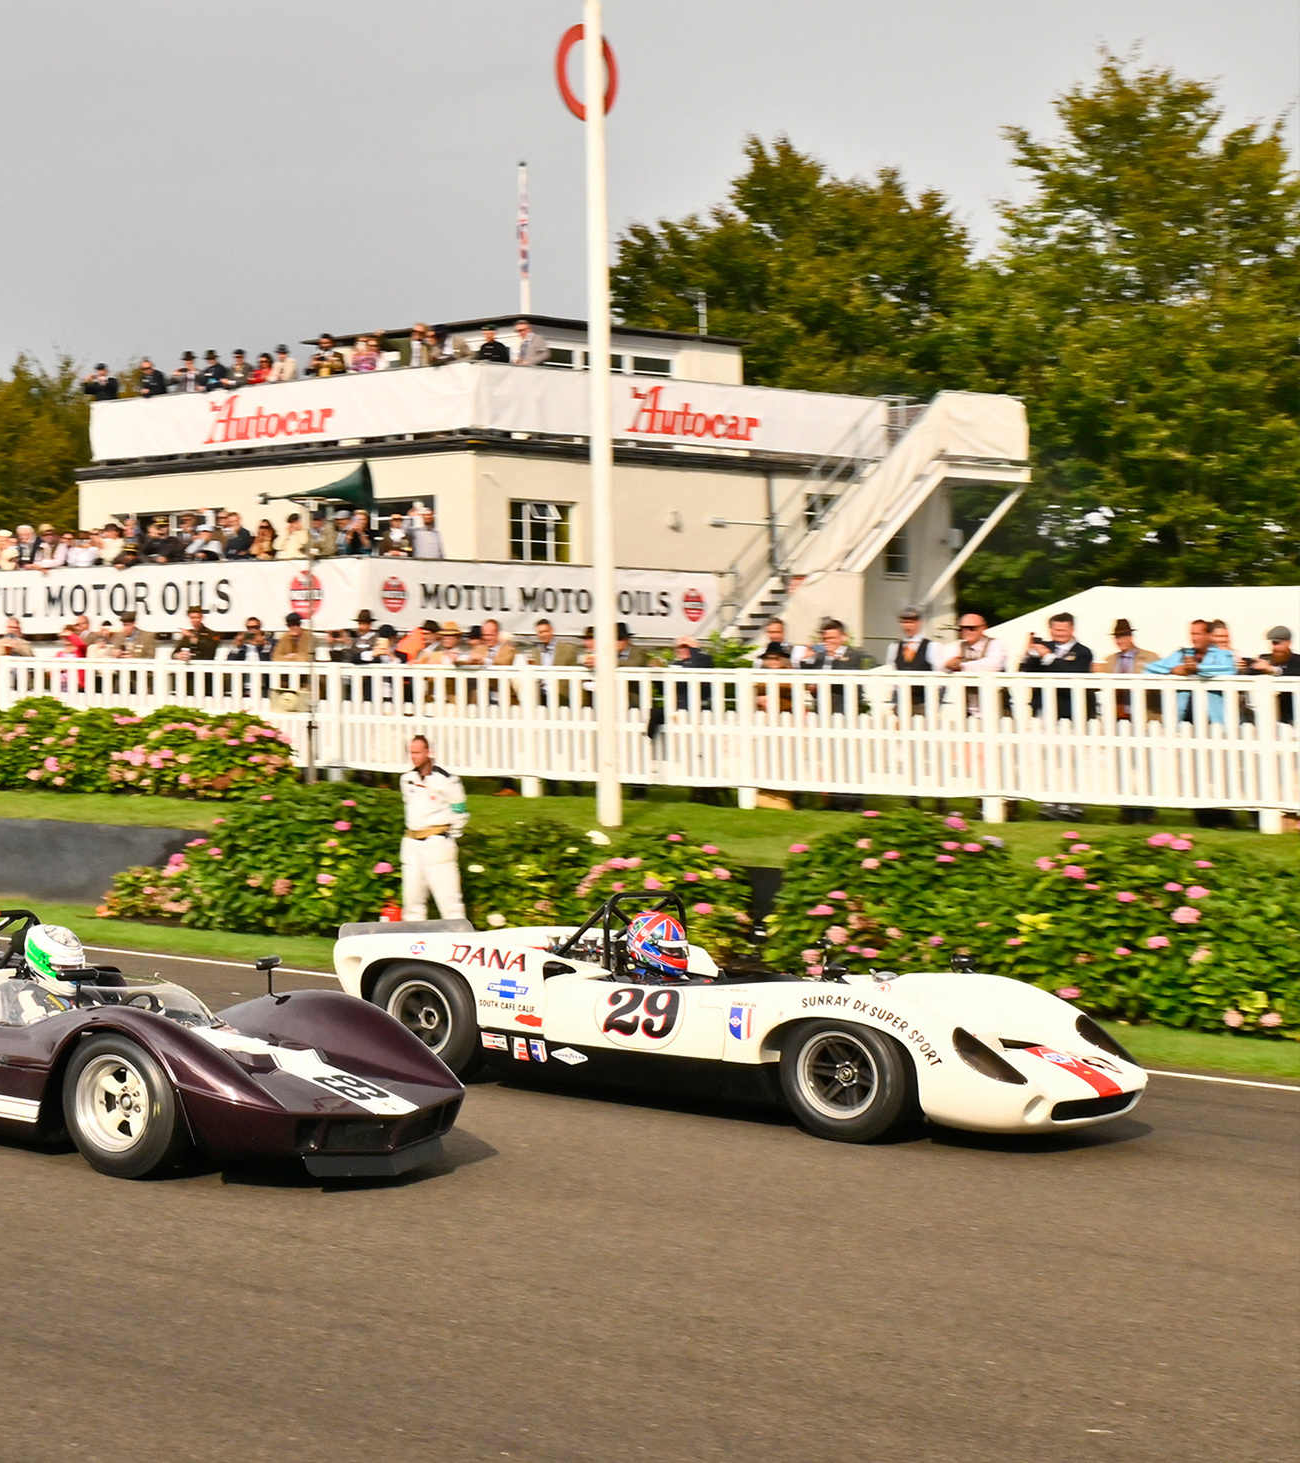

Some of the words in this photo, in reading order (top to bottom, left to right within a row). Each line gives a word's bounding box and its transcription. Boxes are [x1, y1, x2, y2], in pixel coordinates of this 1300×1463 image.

[203, 395, 335, 444] Autocar
[626, 386, 761, 440] Autocar
[46, 582, 152, 617] MOTOR
[162, 579, 231, 615] OILS
[419, 583, 511, 612] MOTUL
[519, 587, 593, 614] MOTO
[618, 590, 671, 617] OILS
[445, 943, 526, 972] DANA
[479, 999, 498, 1008] SOUTH
[603, 988, 680, 1039] 29
[801, 995, 851, 1008] SUNRAY
[853, 1000, 870, 1013] DX
[869, 1006, 909, 1033] SUPER
[908, 1029, 943, 1067] SPORT
[313, 1074, 390, 1100] 69
